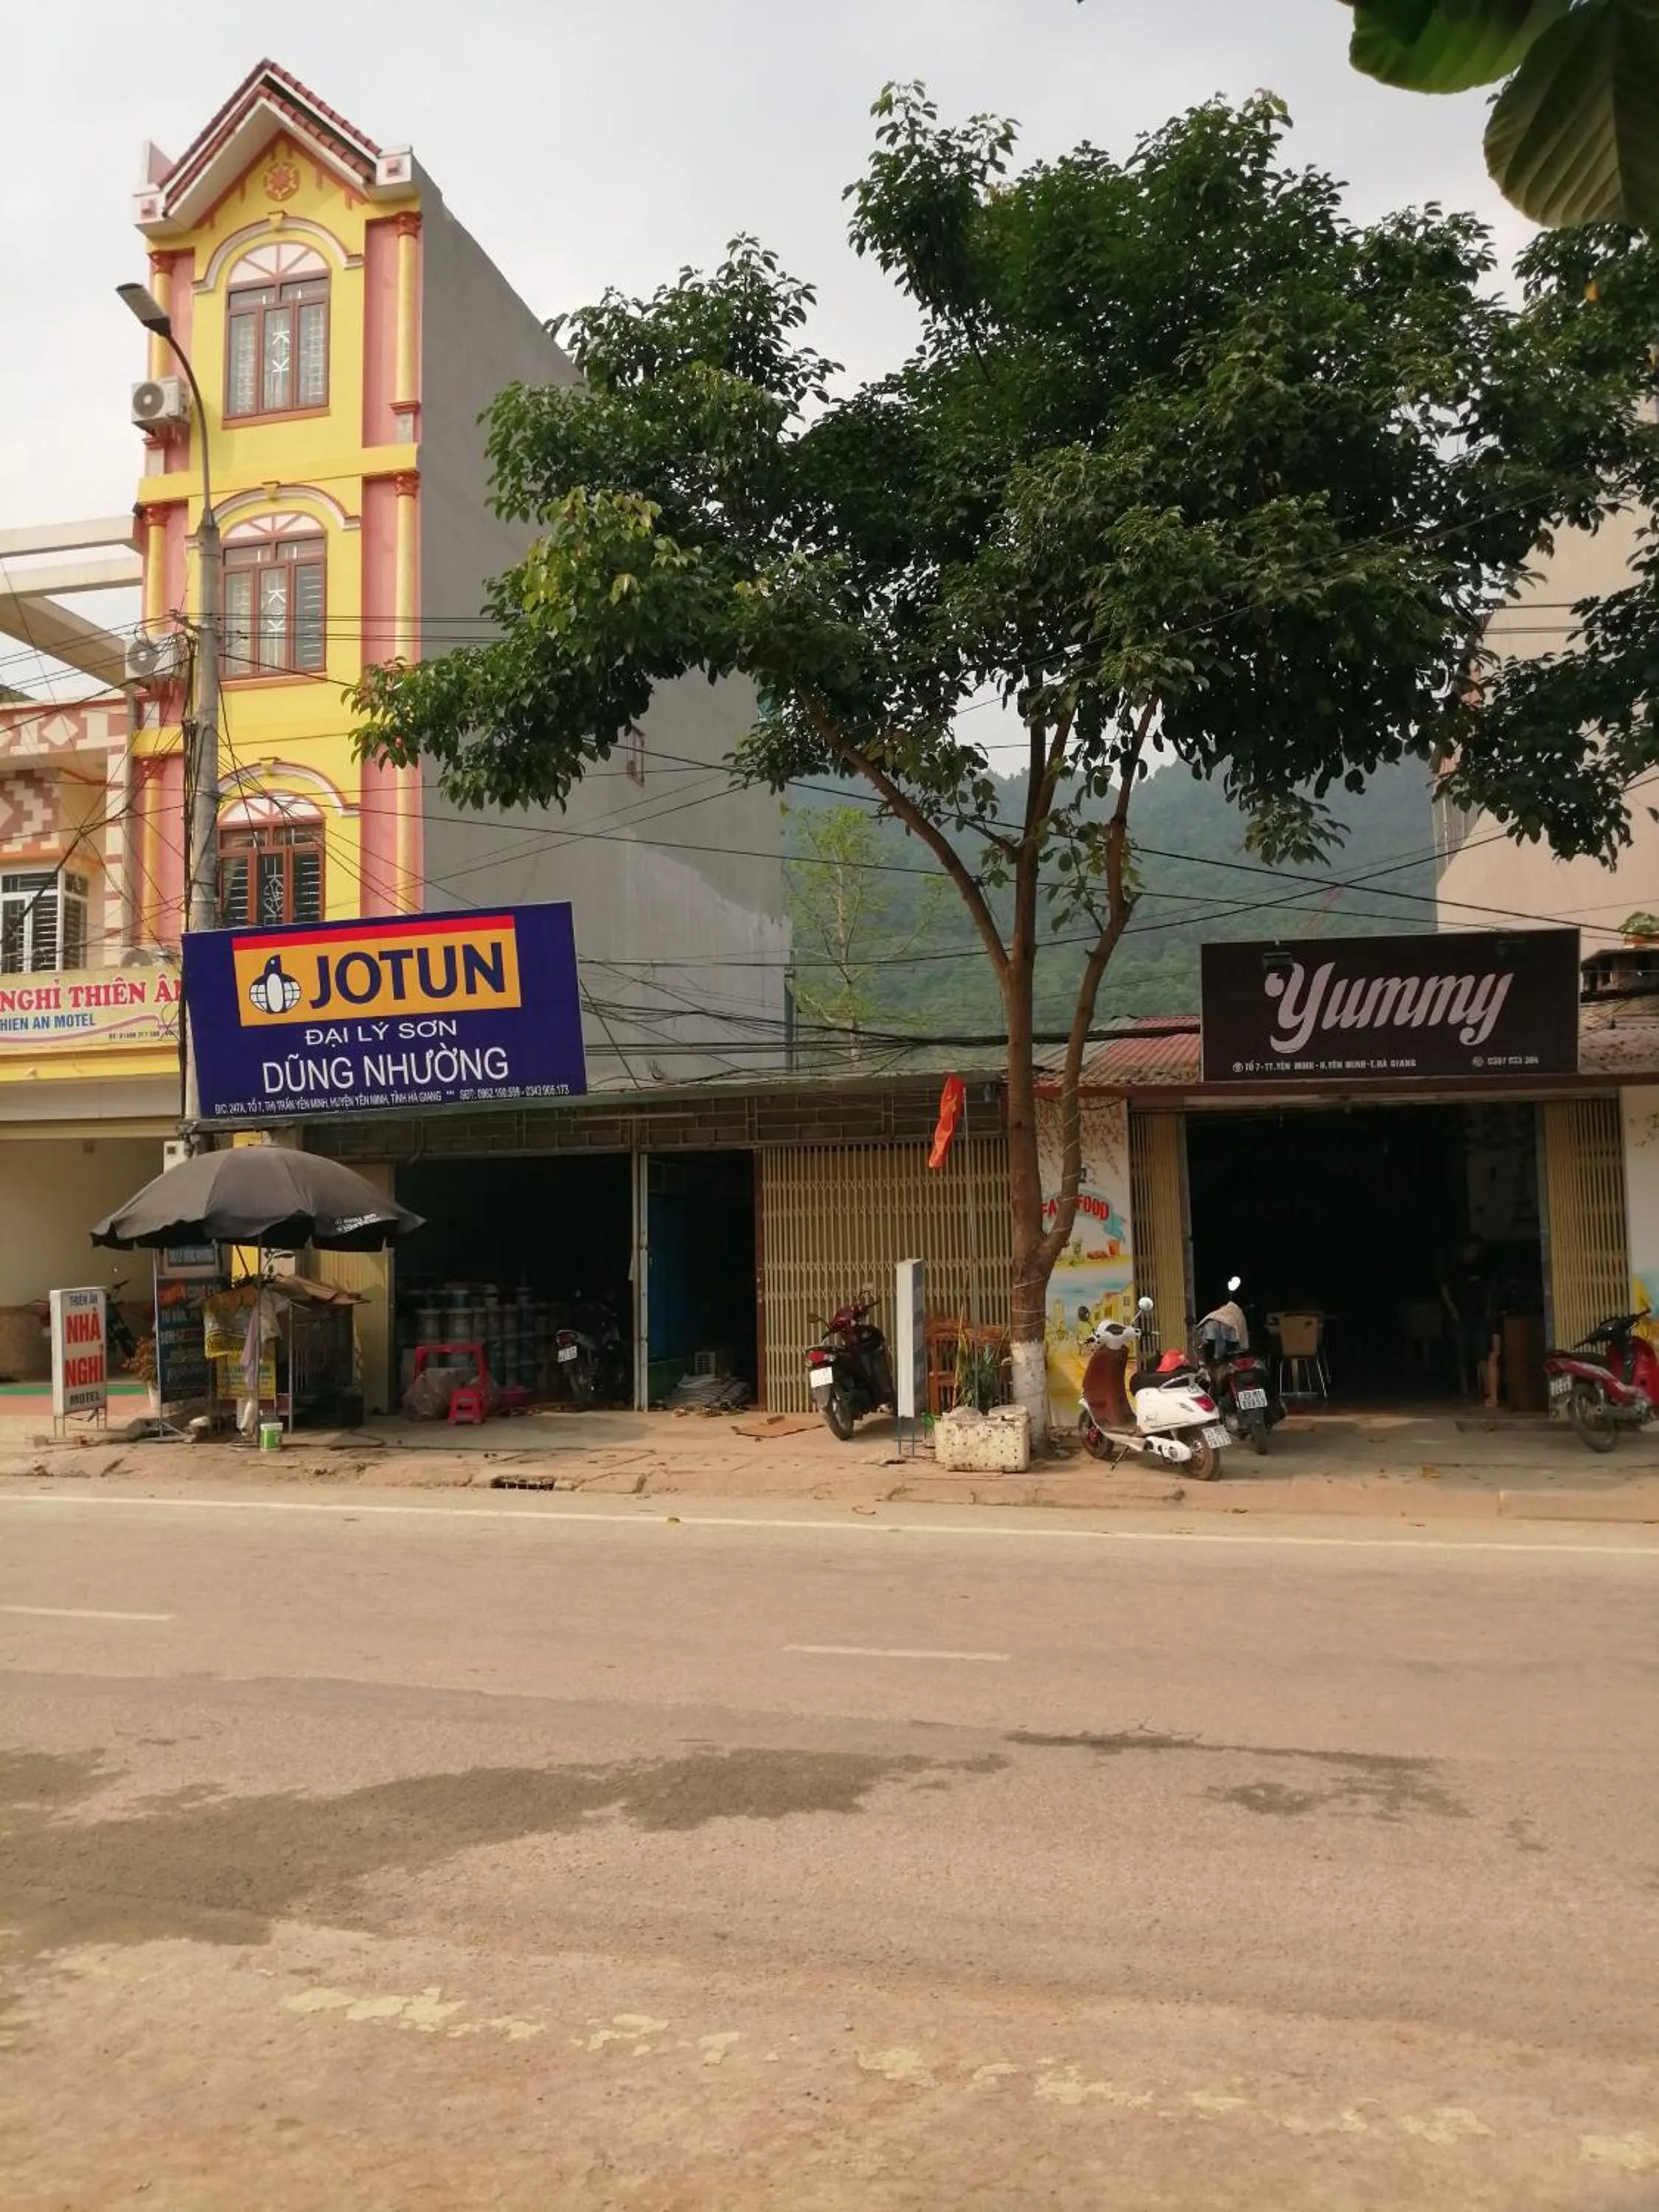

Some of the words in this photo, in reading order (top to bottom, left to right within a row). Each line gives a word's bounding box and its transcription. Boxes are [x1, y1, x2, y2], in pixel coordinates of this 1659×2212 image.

[310, 942, 505, 1009] JOTUN
[0, 979, 61, 1013] NGHỈ
[69, 976, 146, 1008] THIÊN
[1265, 962, 1514, 1054] Yummy
[33, 1015, 50, 1030] AN
[55, 1013, 95, 1029] MOTEL
[305, 1027, 349, 1048] ĐẠI
[358, 1021, 390, 1042] LÝ
[398, 1019, 458, 1039] SƠN
[262, 1053, 355, 1094] DŨNG
[364, 1042, 509, 1087] NHƯỜNG
[408, 1090, 418, 1103] HÀ
[419, 1091, 442, 1103] GIANG
[1074, 1194, 1110, 1220] FOOD
[66, 1307, 101, 1344] NHÀ
[65, 1343, 104, 1388] NGHỈ
[70, 1391, 101, 1405] MOTEL
